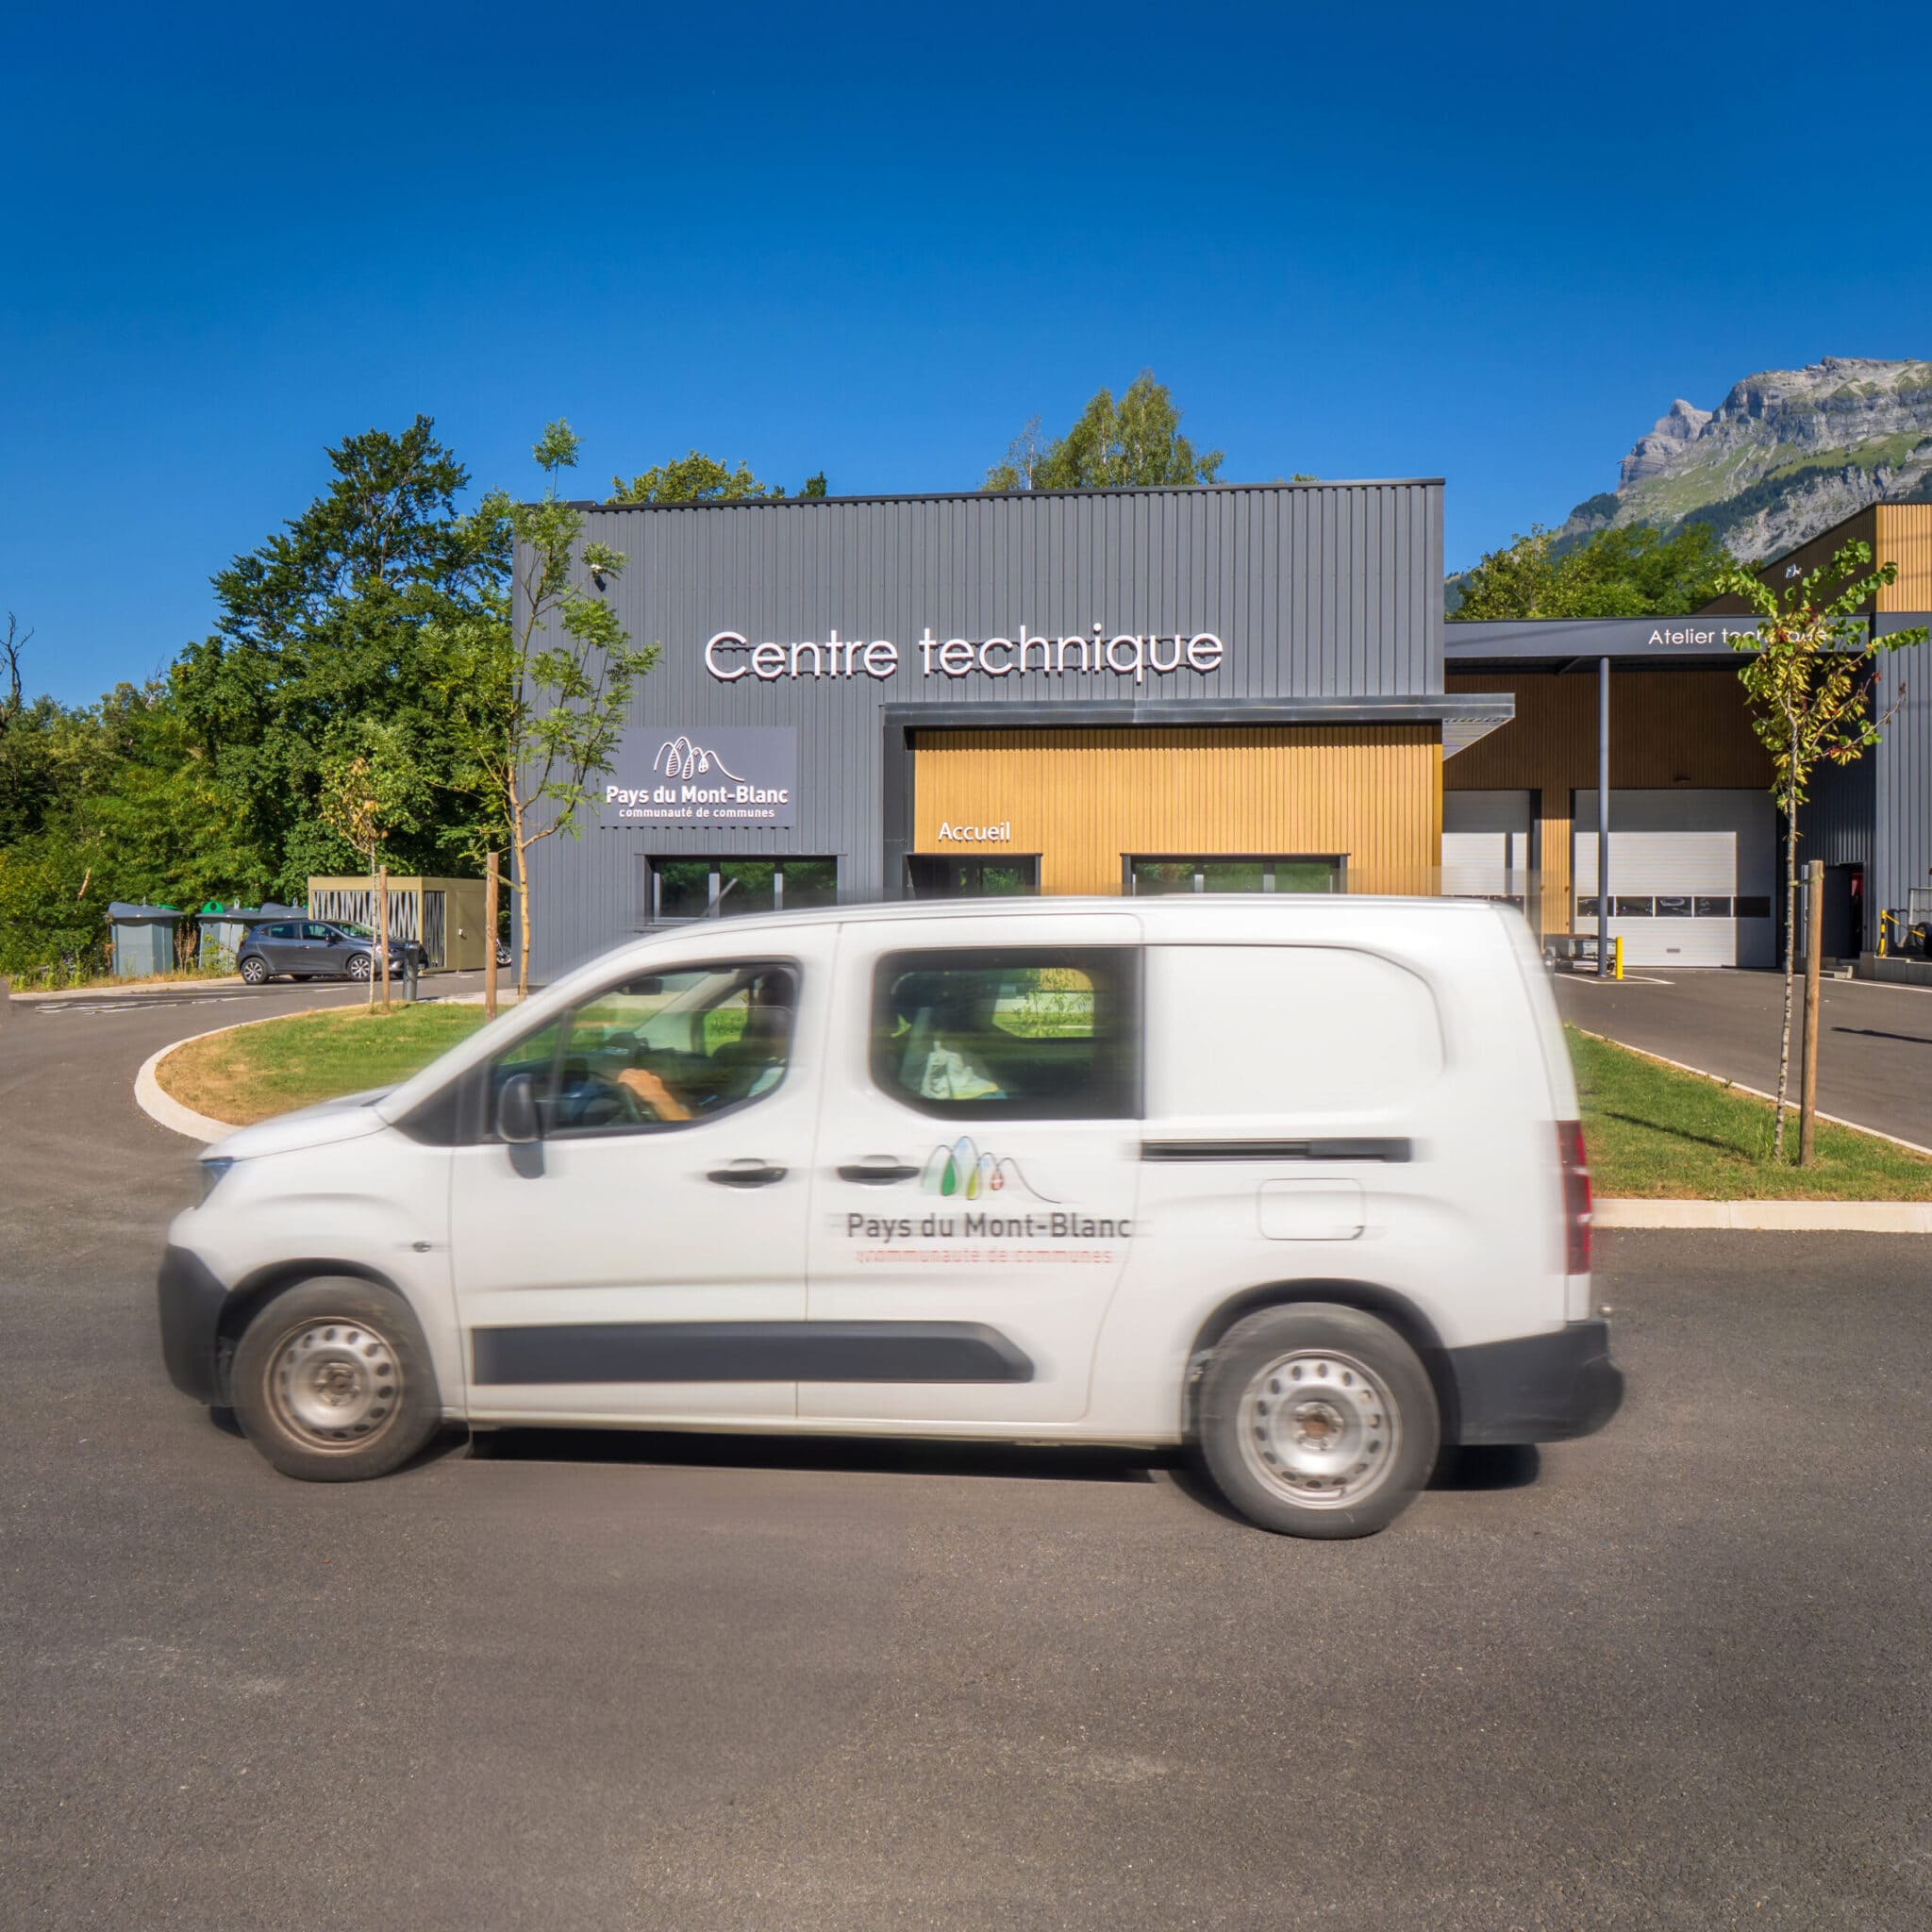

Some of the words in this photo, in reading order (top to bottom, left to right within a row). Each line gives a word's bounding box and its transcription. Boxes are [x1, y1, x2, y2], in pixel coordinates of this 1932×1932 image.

[1648, 628, 1715, 644] Atelier
[706, 630, 898, 678] Centre
[919, 623, 1223, 683] technique
[606, 786, 649, 808] Pays
[654, 786, 675, 803] du
[682, 785, 789, 803] Mont-Blanc
[619, 807, 692, 818] communauté
[696, 808, 709, 818] de
[713, 808, 774, 818] communes
[938, 821, 1010, 841] Accueil
[848, 1212, 911, 1243] Pays
[921, 1212, 953, 1238] du
[965, 1212, 1132, 1238] Mont-Blanc
